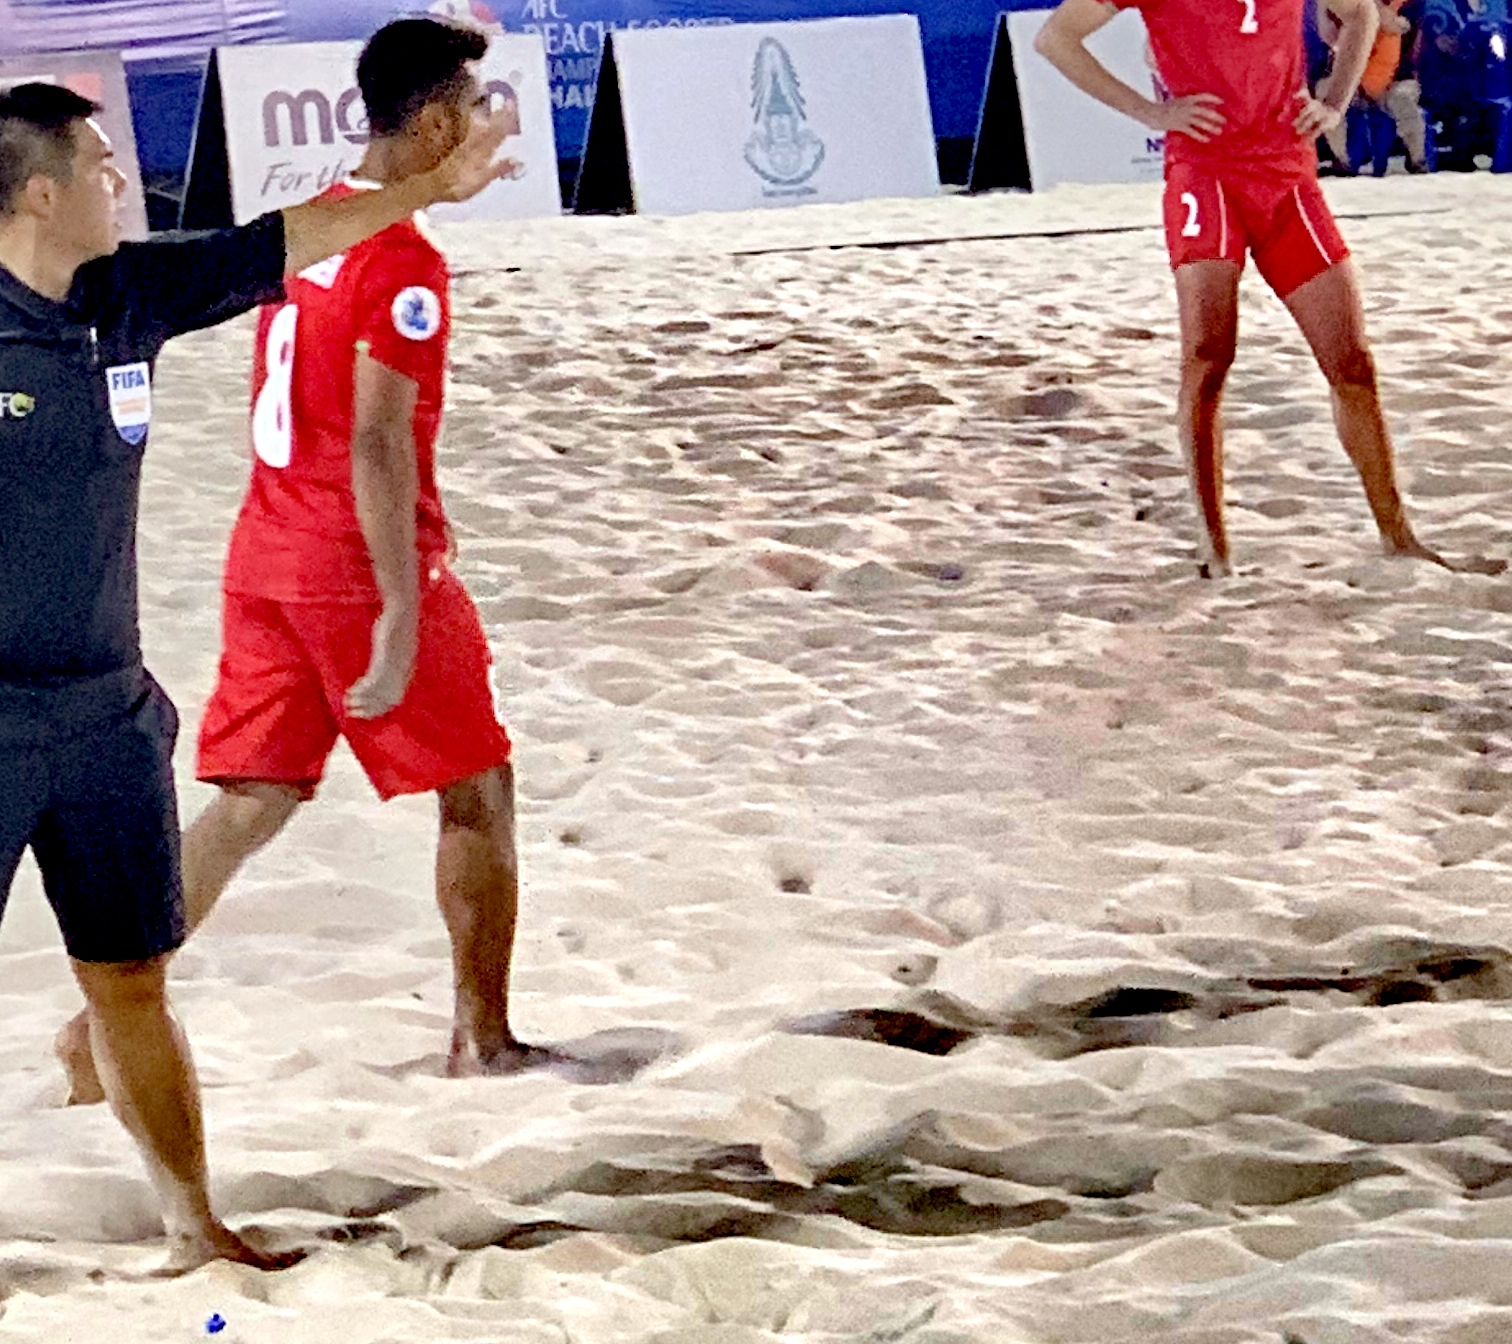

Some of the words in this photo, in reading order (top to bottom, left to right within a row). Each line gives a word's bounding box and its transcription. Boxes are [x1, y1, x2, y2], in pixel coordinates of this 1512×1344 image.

[261, 161, 307, 197] For
[1181, 193, 1201, 237] 2
[111, 370, 146, 391] FIFA
[252, 303, 299, 469] 8
